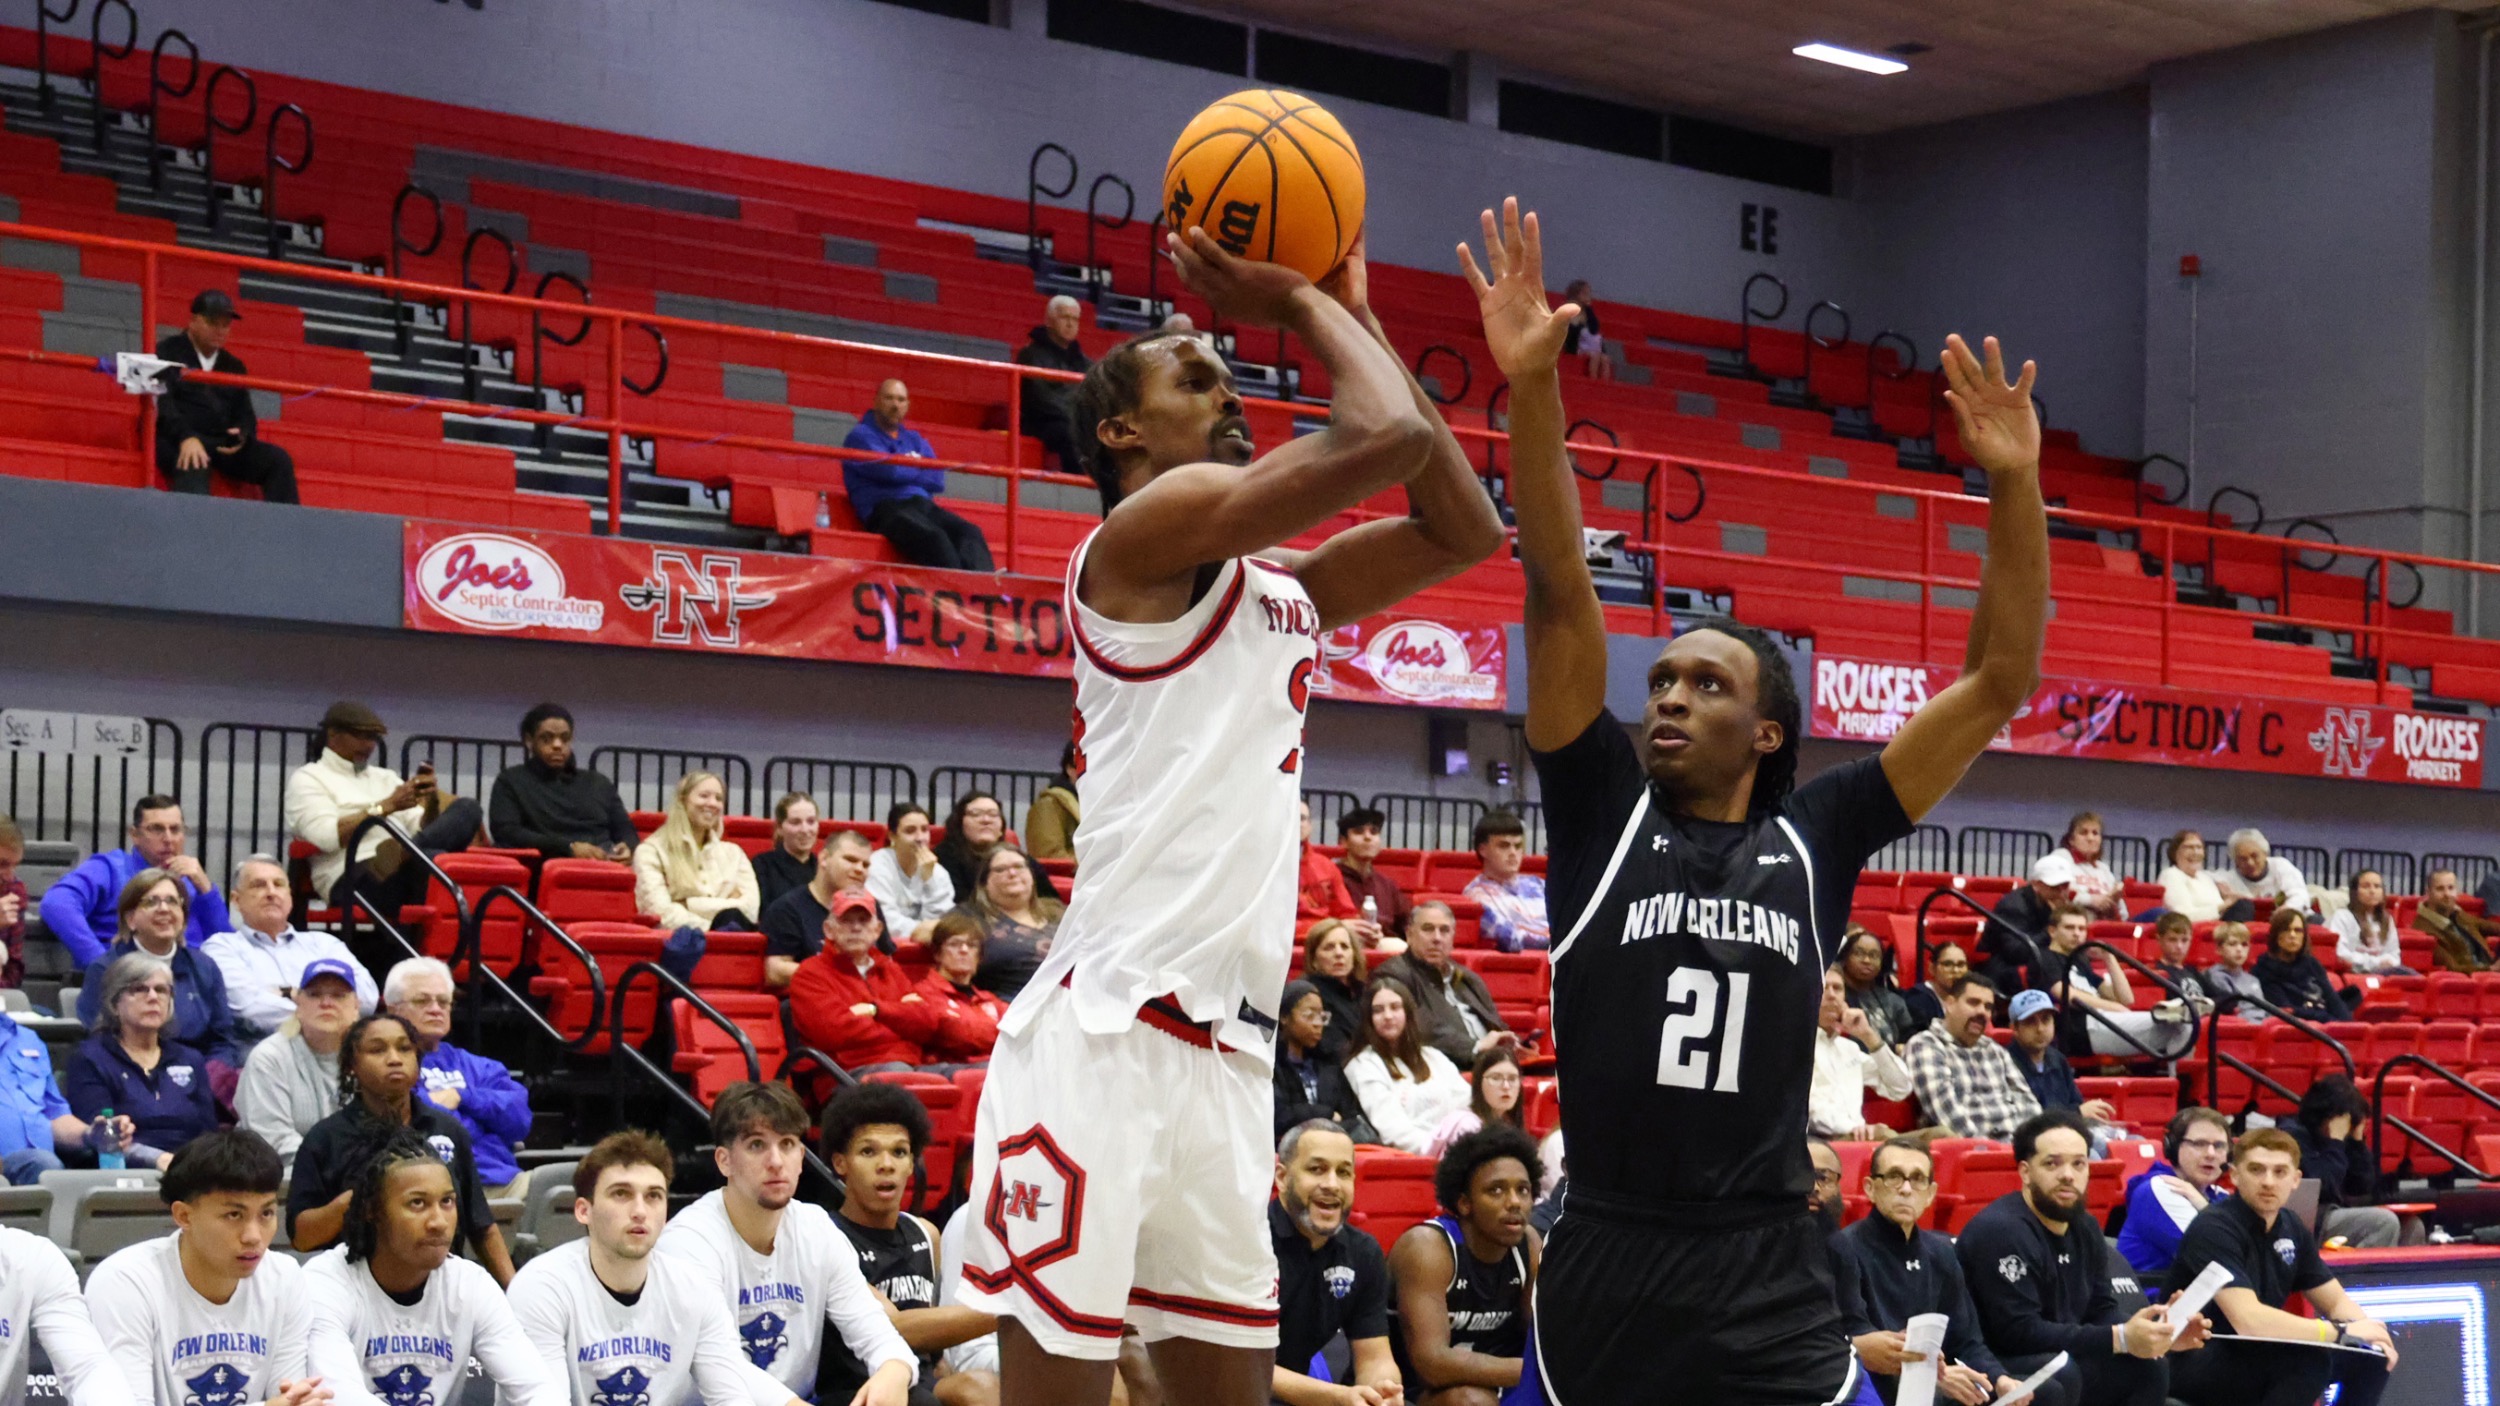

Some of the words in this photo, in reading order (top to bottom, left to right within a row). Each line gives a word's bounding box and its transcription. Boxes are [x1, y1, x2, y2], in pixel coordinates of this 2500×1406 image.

[1741, 203, 1778, 255] EE
[438, 544, 532, 601] Joe's
[459, 589, 507, 609] Septic
[512, 596, 600, 615] Contractors
[851, 582, 1075, 658] SECTIO
[1382, 630, 1446, 678] Joe's
[1432, 670, 1493, 686] Contractor
[1816, 659, 1928, 714] ROUSES
[5, 715, 35, 737] Sec.
[41, 719, 53, 739] A
[95, 721, 124, 742] Sec.
[132, 723, 143, 743] B
[2057, 694, 2242, 753] SECTION
[2258, 710, 2285, 758] C
[2394, 714, 2480, 762] ROUSES
[2407, 759, 2462, 782] MARKETS
[1620, 892, 1685, 946] NEW
[1687, 898, 1800, 966] ORLEANS
[1656, 966, 1750, 1093] 21
